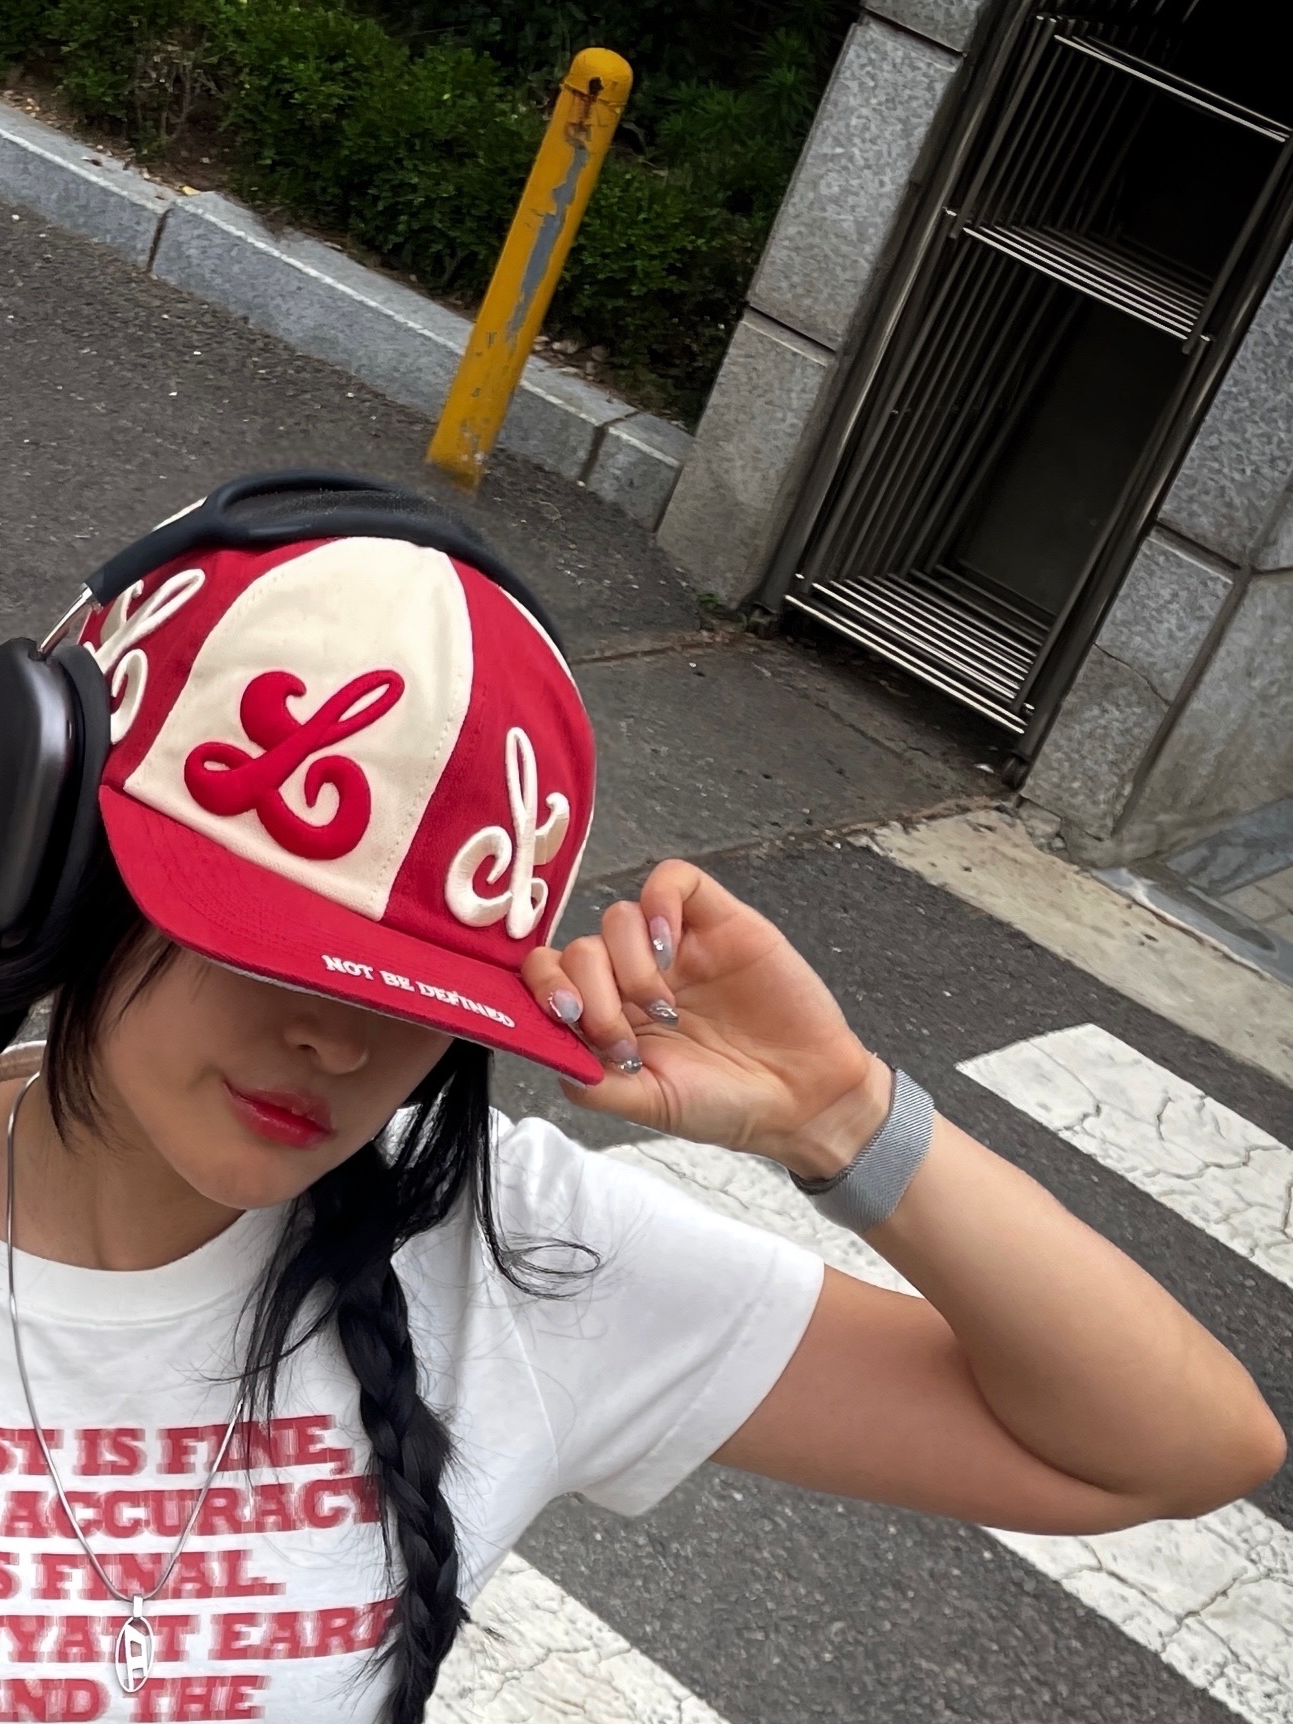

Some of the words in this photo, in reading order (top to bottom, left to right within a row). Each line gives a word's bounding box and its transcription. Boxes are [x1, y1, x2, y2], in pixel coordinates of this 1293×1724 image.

[321, 954, 374, 980] NOT
[379, 970, 415, 992] BE
[72, 1427, 145, 1476] IS
[129, 1675, 271, 1723] THE
